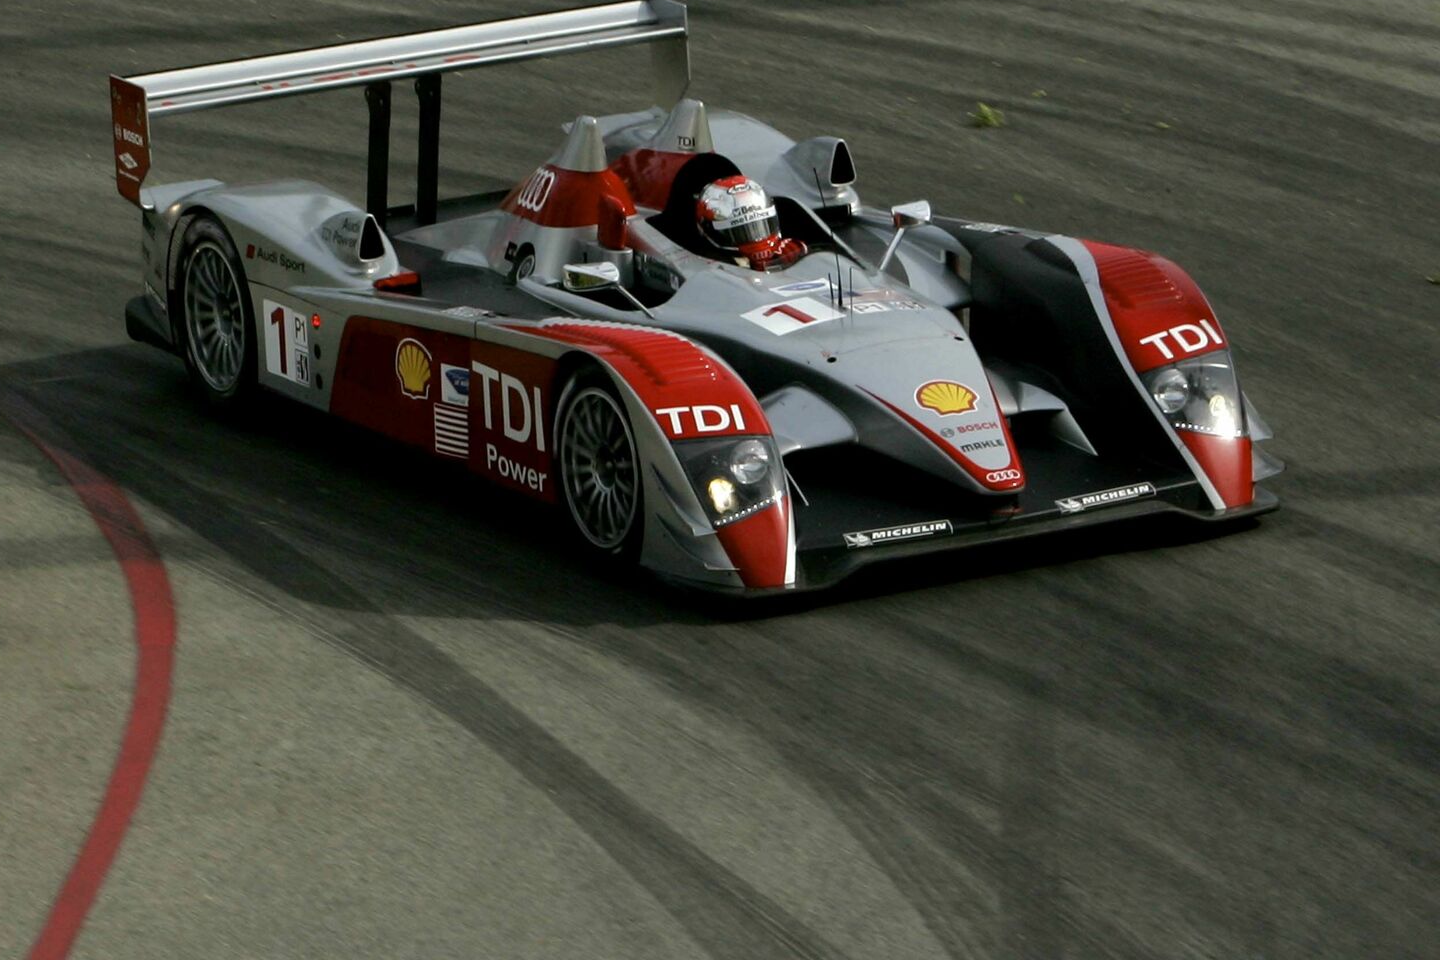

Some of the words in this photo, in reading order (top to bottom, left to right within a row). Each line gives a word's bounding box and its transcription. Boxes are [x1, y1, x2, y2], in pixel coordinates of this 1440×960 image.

[677, 136, 696, 147] TDI
[257, 246, 278, 263] Audi
[279, 254, 306, 274] Sport
[763, 303, 818, 324] 1
[270, 306, 288, 375] 1
[294, 317, 307, 342] P1
[1139, 318, 1223, 360] TDI
[471, 359, 546, 453] TDI
[655, 403, 746, 435] TDI
[956, 421, 999, 434] BOSCH
[960, 438, 1005, 454] MAHLE
[486, 442, 548, 493] Power
[1081, 484, 1150, 505] MICHELIN
[872, 522, 947, 540] MICHELIN
